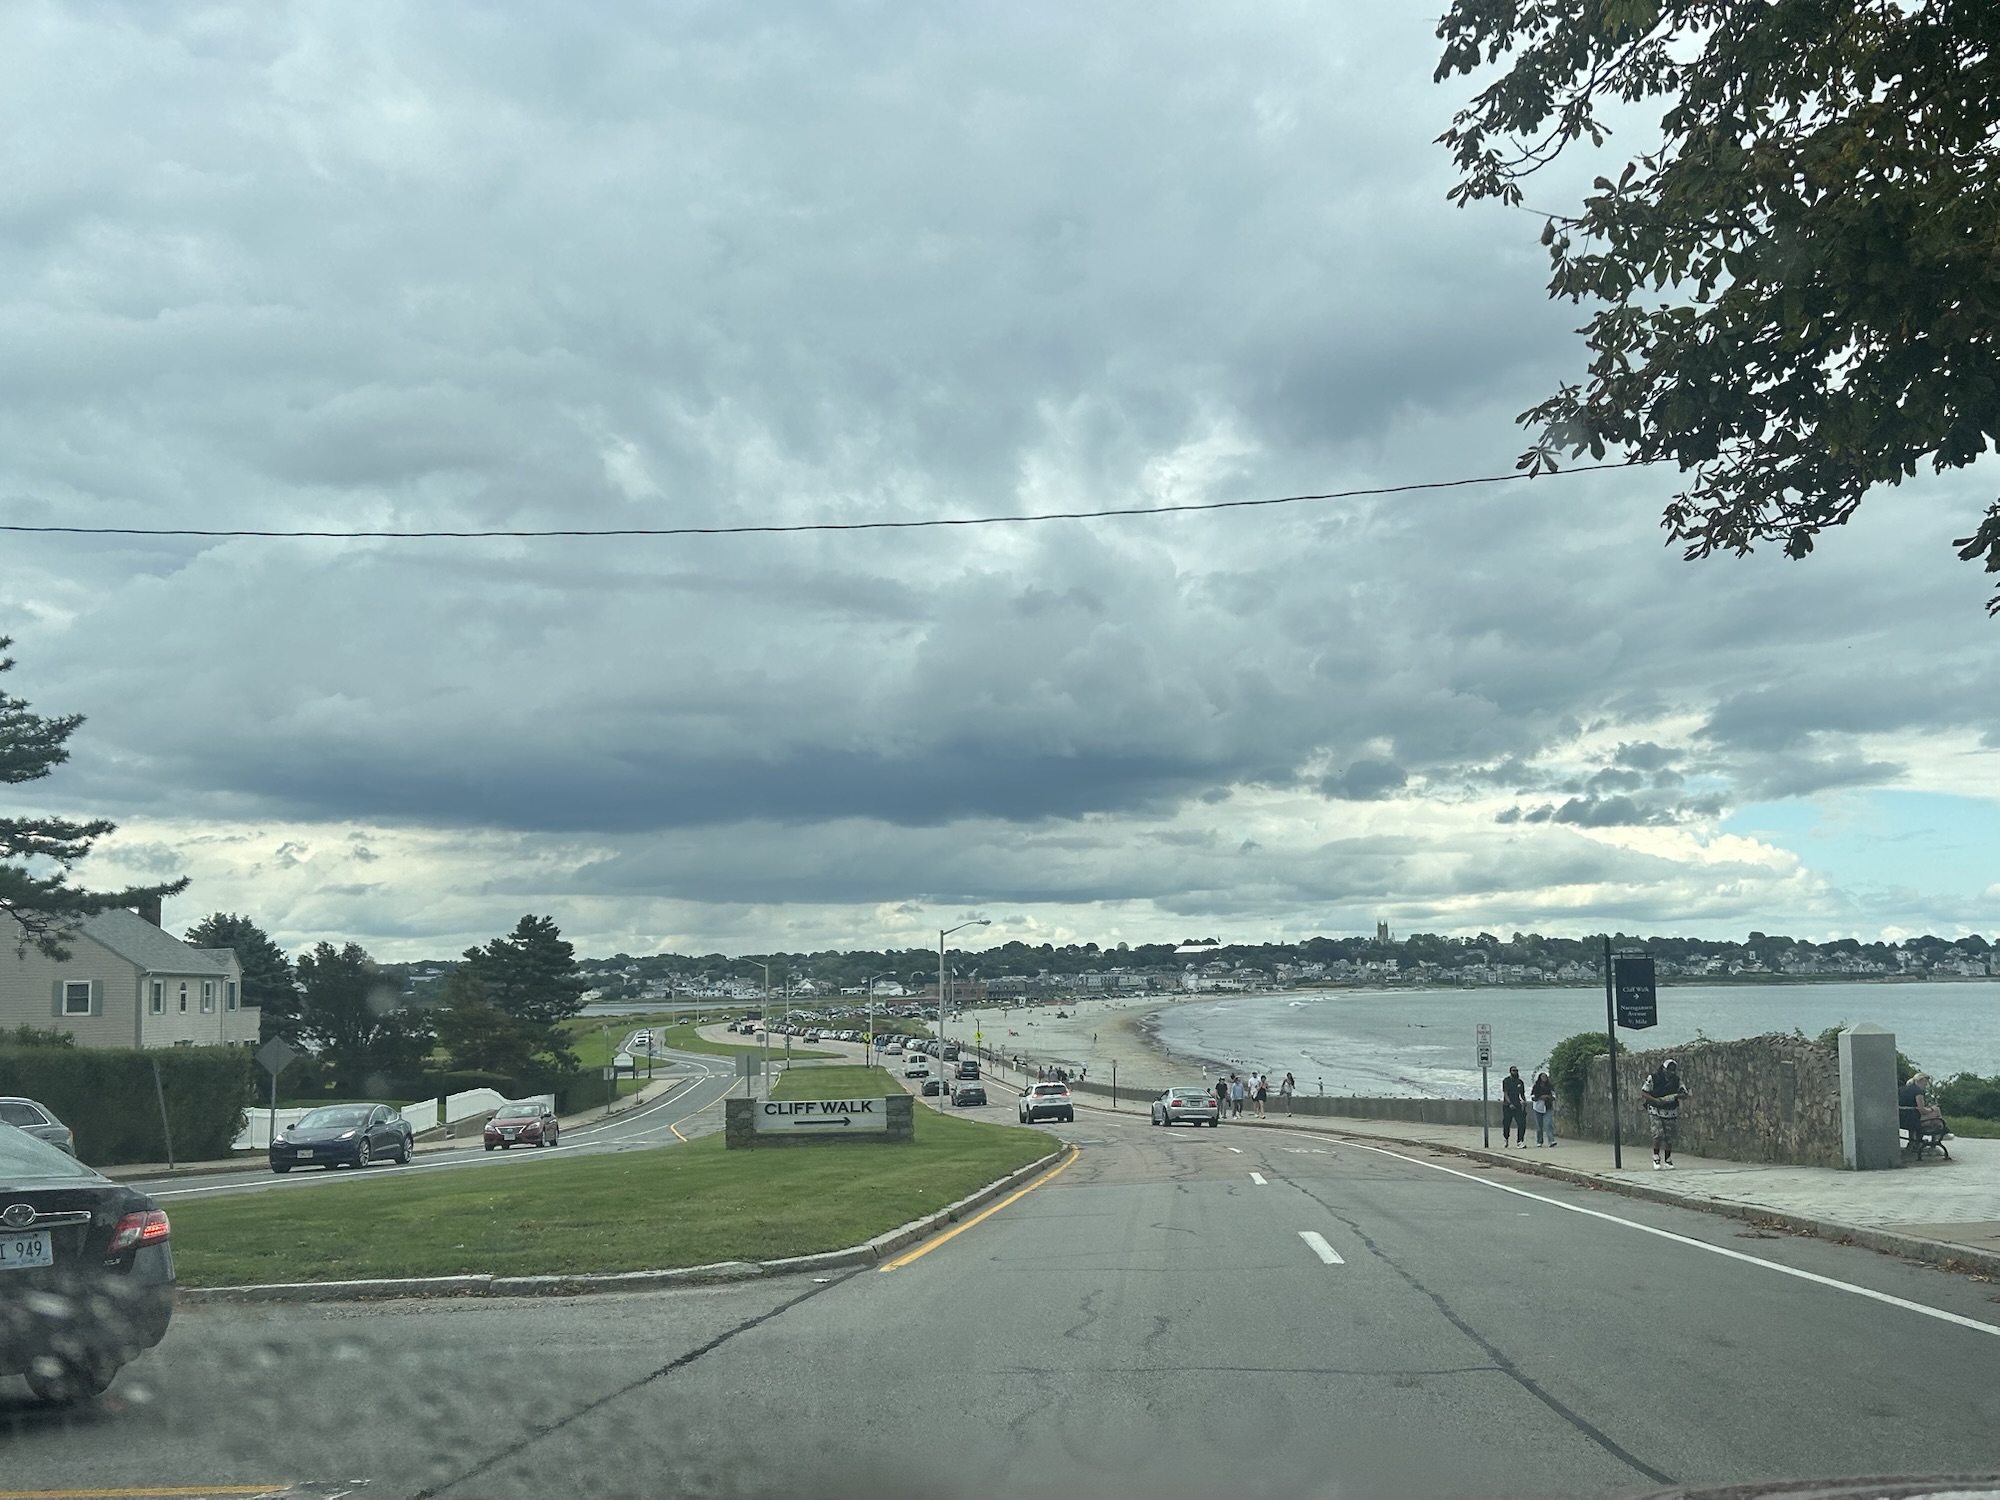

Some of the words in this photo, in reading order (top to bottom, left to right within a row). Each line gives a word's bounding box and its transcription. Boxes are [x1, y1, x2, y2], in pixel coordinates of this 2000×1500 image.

[764, 1102, 817, 1115] CLIFF
[820, 1101, 873, 1113] WALK
[16, 1241, 42, 1258] 949
